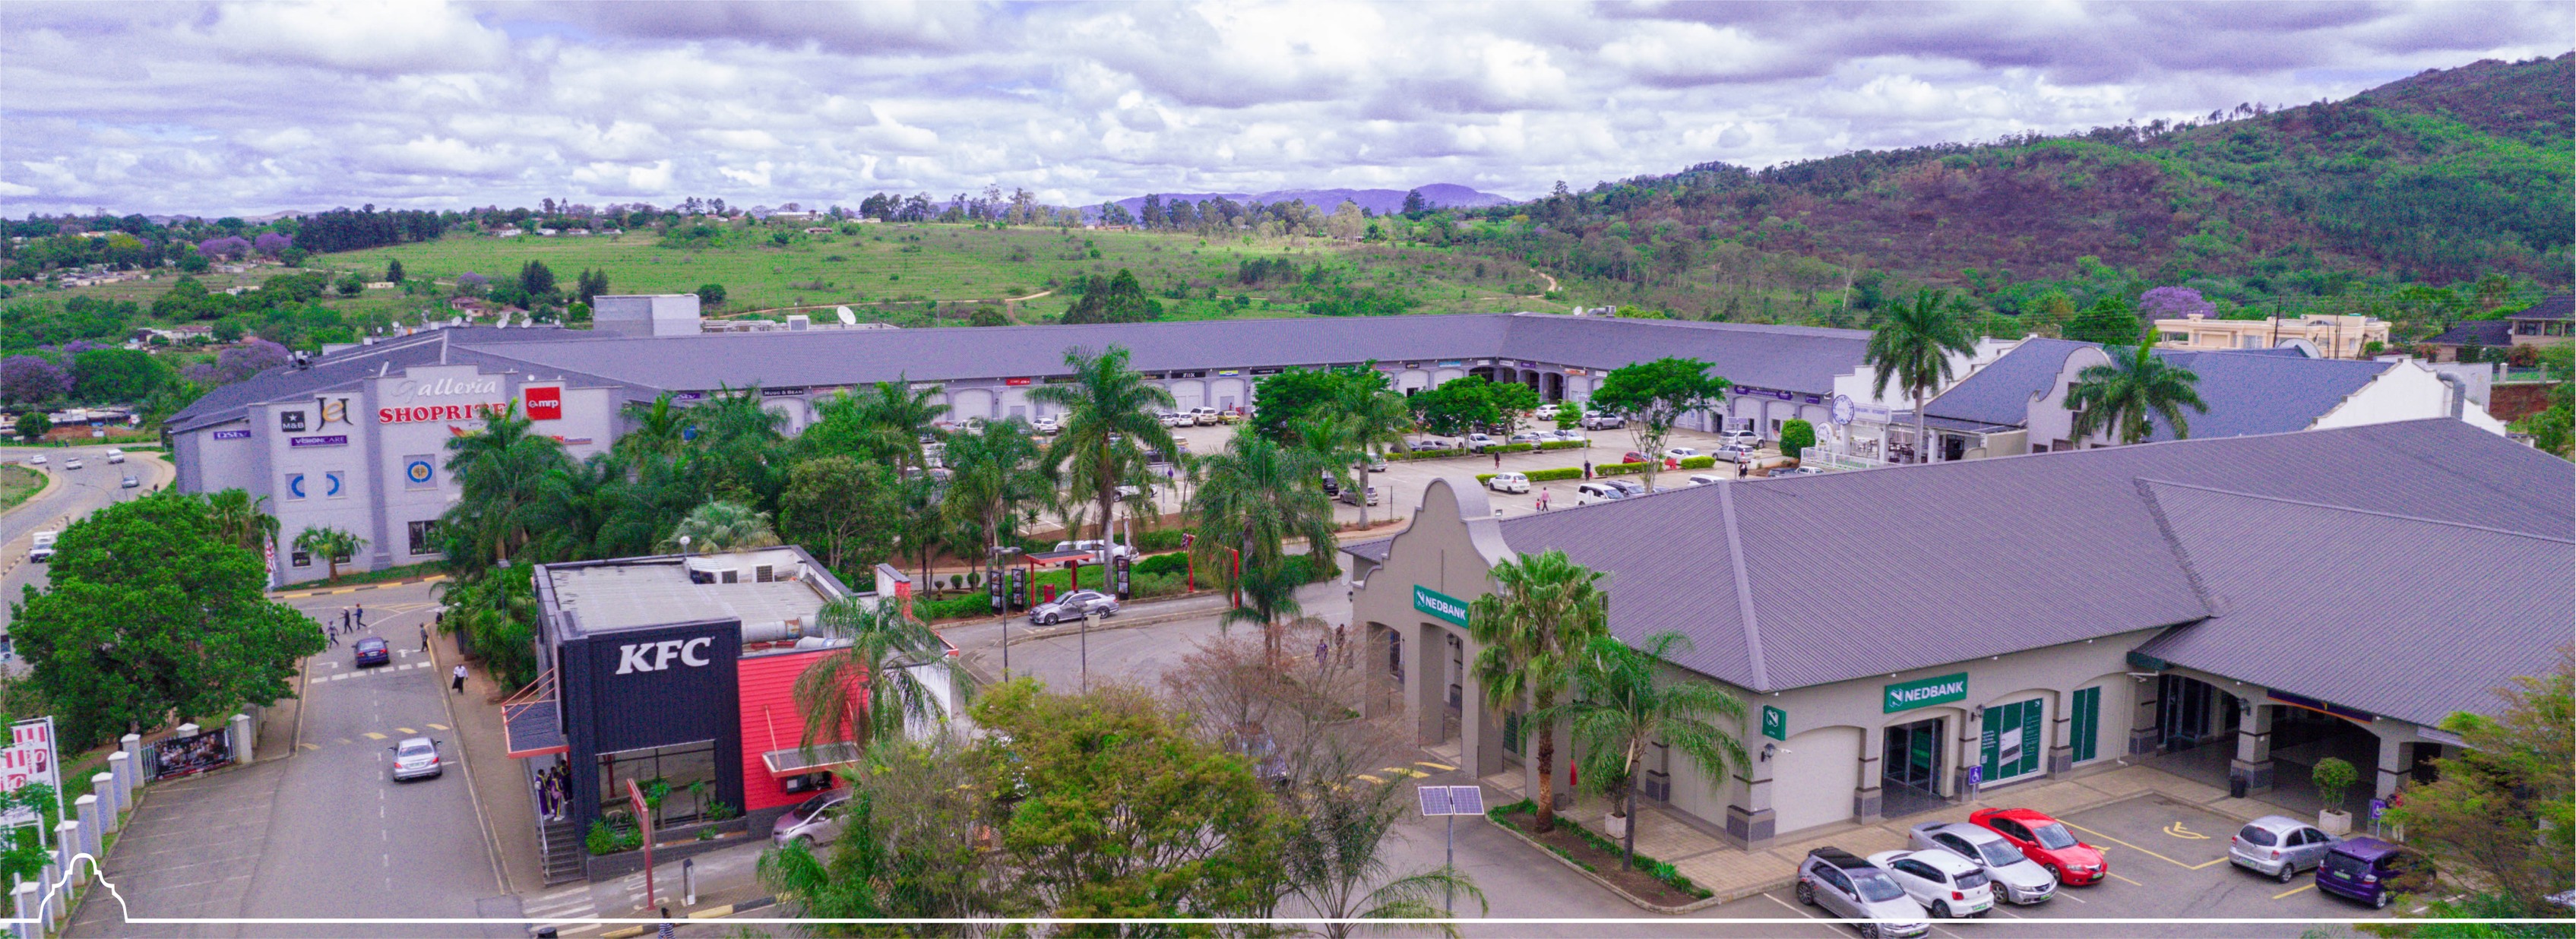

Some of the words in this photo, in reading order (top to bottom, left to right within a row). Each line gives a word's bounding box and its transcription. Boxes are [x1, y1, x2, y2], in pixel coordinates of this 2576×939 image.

[1425, 595, 1466, 621] NEDBANK
[615, 637, 712, 675] KFC
[1904, 681, 1964, 703] NEDBANK
